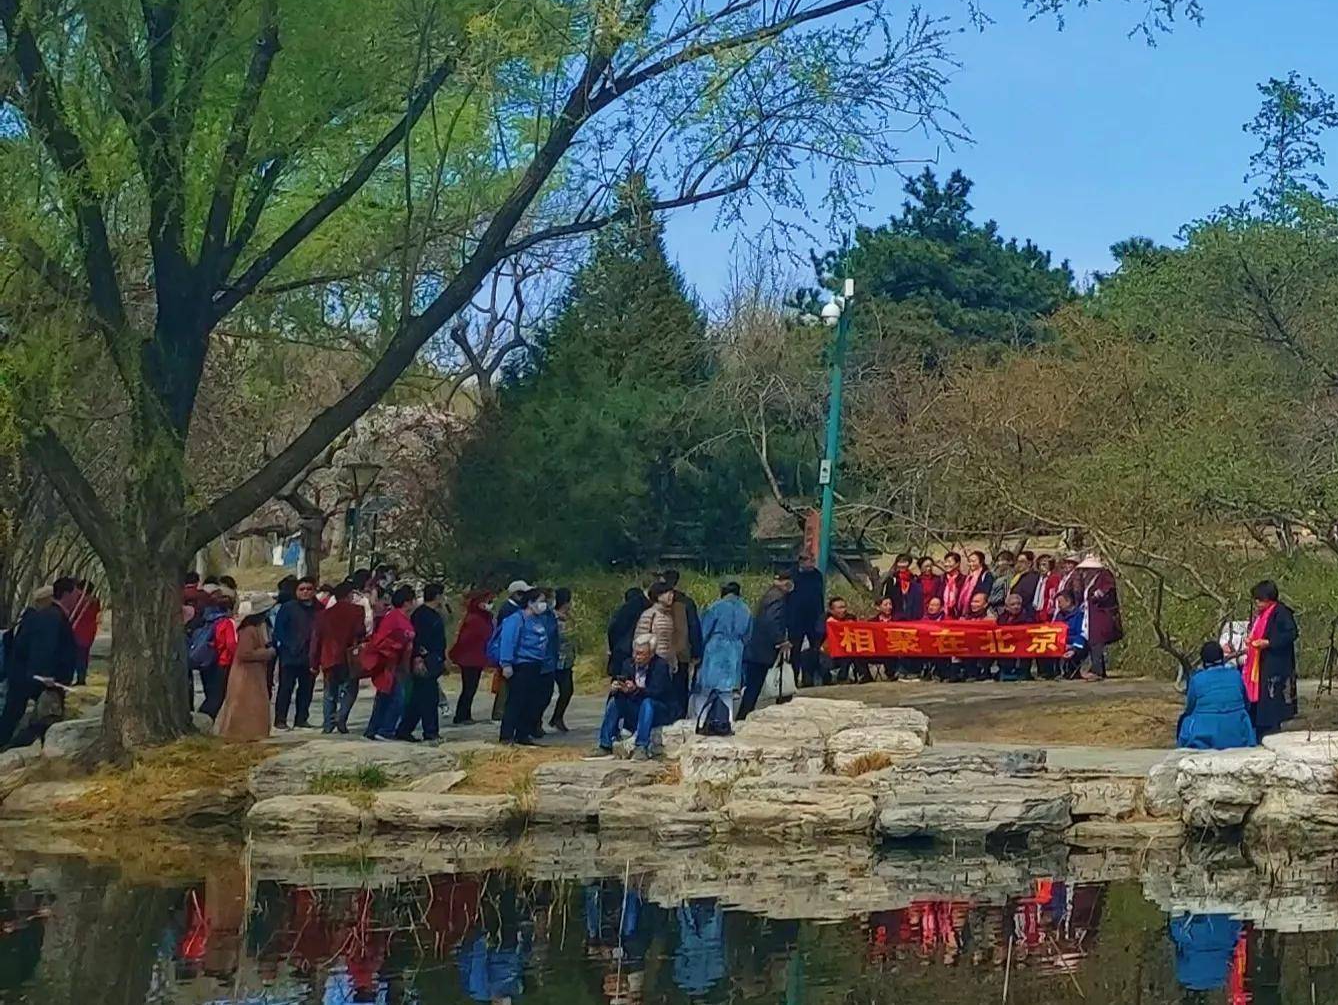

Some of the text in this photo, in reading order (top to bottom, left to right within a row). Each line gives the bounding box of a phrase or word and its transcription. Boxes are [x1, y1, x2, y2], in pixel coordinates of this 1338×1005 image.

[839, 626, 1063, 654] 相聚在北京
